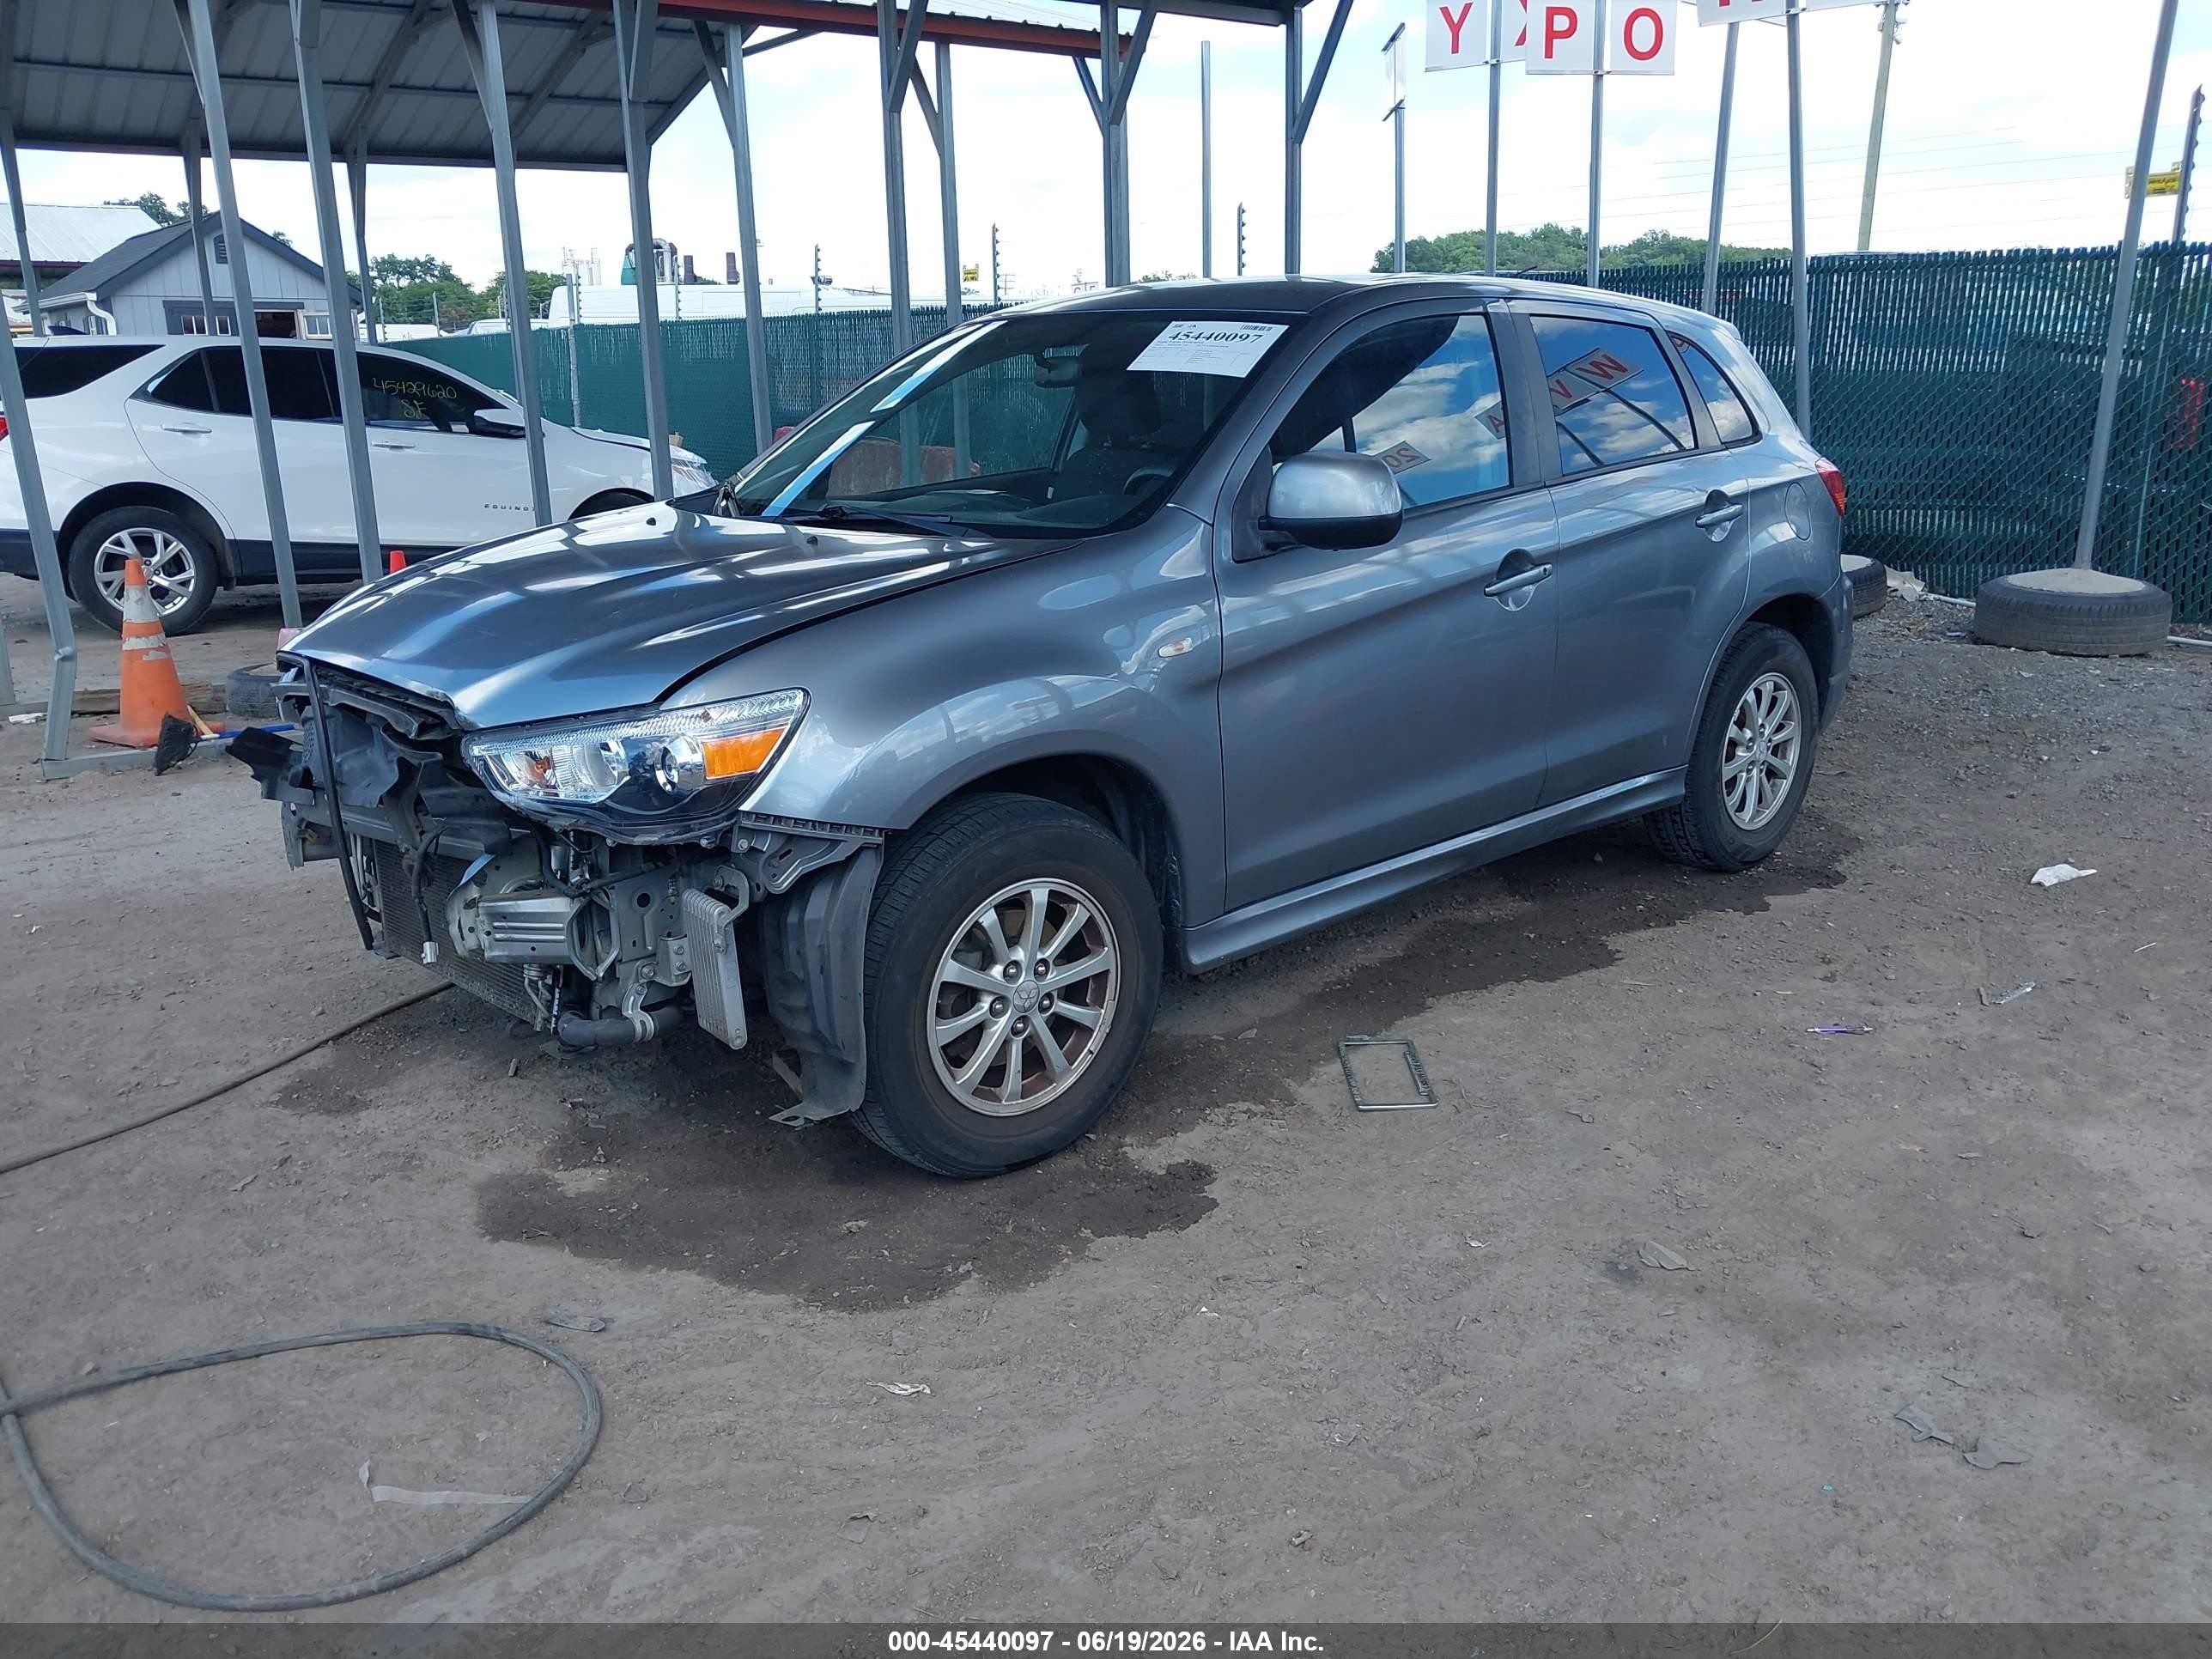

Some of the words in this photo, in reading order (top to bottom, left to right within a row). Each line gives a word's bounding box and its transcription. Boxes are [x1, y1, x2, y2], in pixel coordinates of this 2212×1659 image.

[1439, 3, 1472, 55] Y
[1544, 6, 1578, 59] P
[1623, 8, 1664, 61] O
[1168, 331, 1264, 343] 45440097
[372, 378, 457, 399] 45429620
